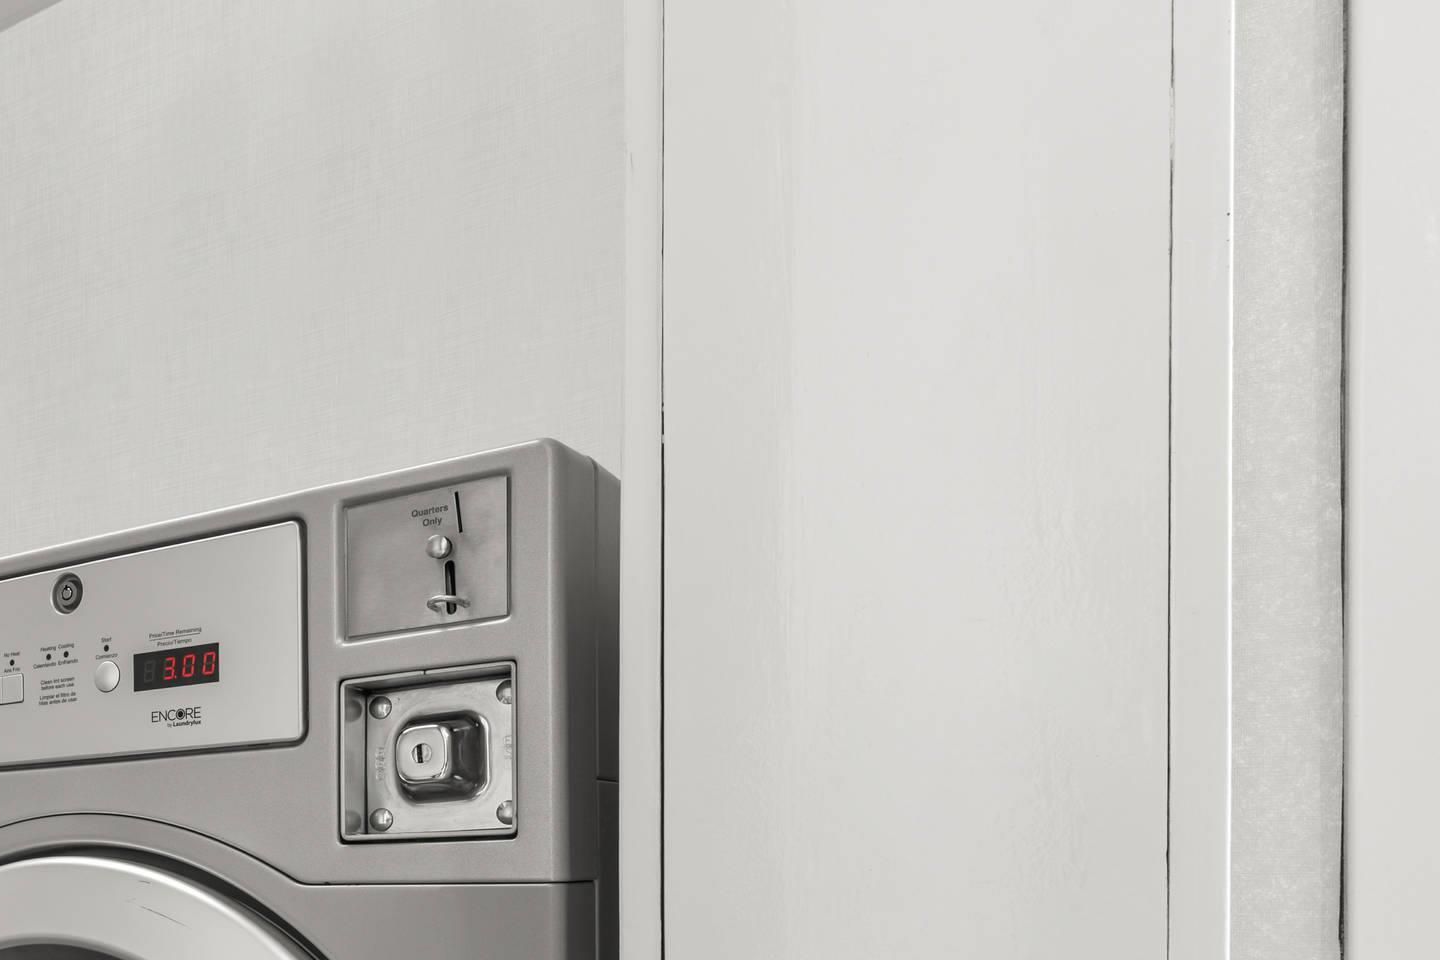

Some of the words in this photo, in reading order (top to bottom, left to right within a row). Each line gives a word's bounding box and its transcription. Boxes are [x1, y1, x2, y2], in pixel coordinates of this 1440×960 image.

[411, 505, 449, 518] Quarters
[422, 517, 442, 527] Only
[176, 627, 202, 635] Remaining
[163, 650, 217, 681] 3.00
[151, 706, 202, 723] ENCORE
[172, 720, 202, 728] Laundrylux
